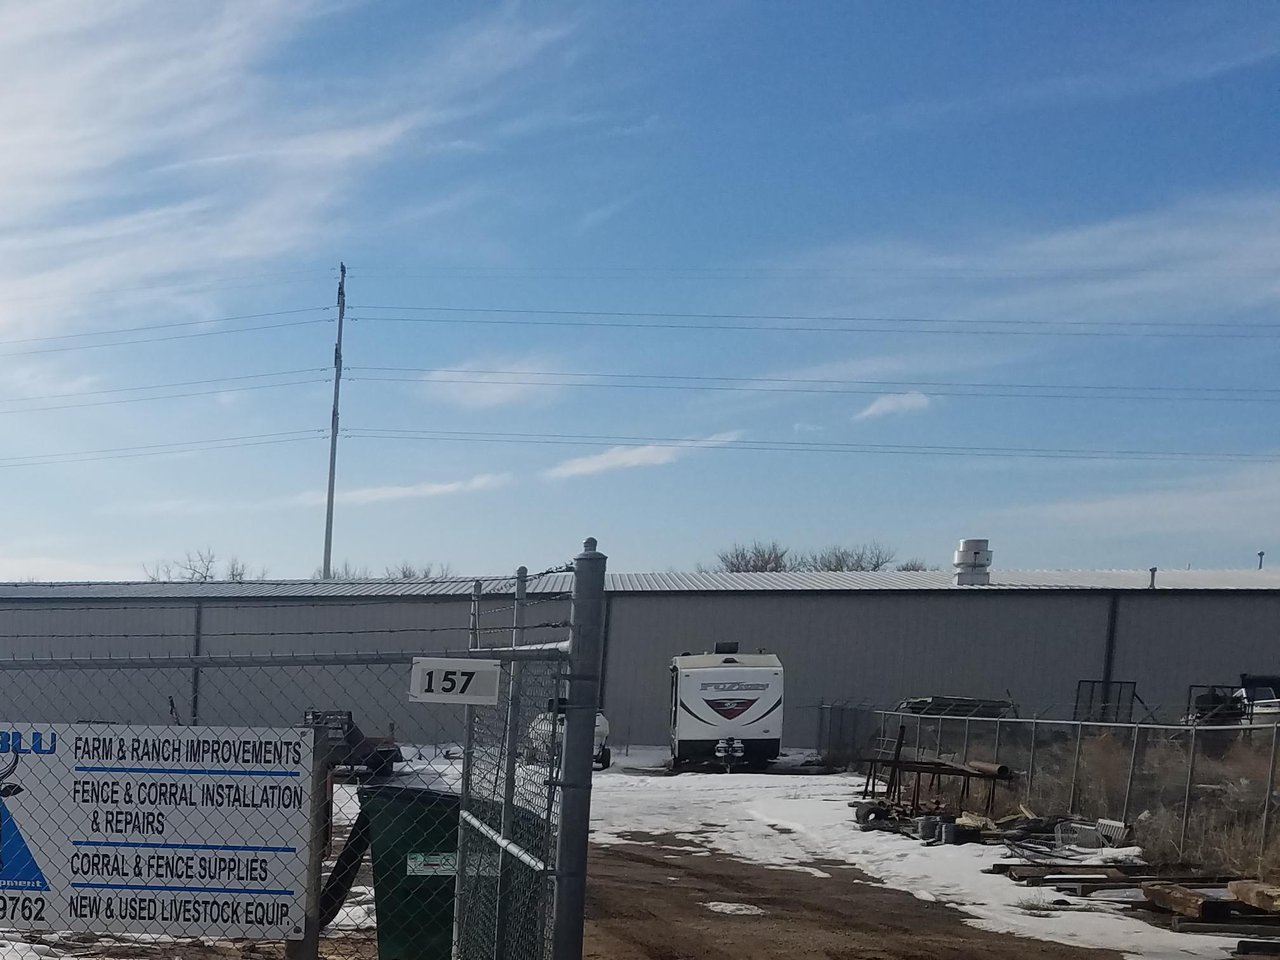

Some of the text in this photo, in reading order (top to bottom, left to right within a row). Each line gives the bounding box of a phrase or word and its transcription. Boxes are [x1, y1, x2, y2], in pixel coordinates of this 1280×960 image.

[424, 671, 476, 694] 157
[74, 736, 301, 765] FARM & RANCH IMPROVEMENTS
[73, 780, 303, 809] FENCE & CORRAL INSTALLATION
[91, 810, 165, 835] & REPAIRS
[70, 852, 268, 881] CORRAL & FENCE SUPPLIES
[69, 895, 290, 927] NEW & USED LIVESTOCK EQUIP.
